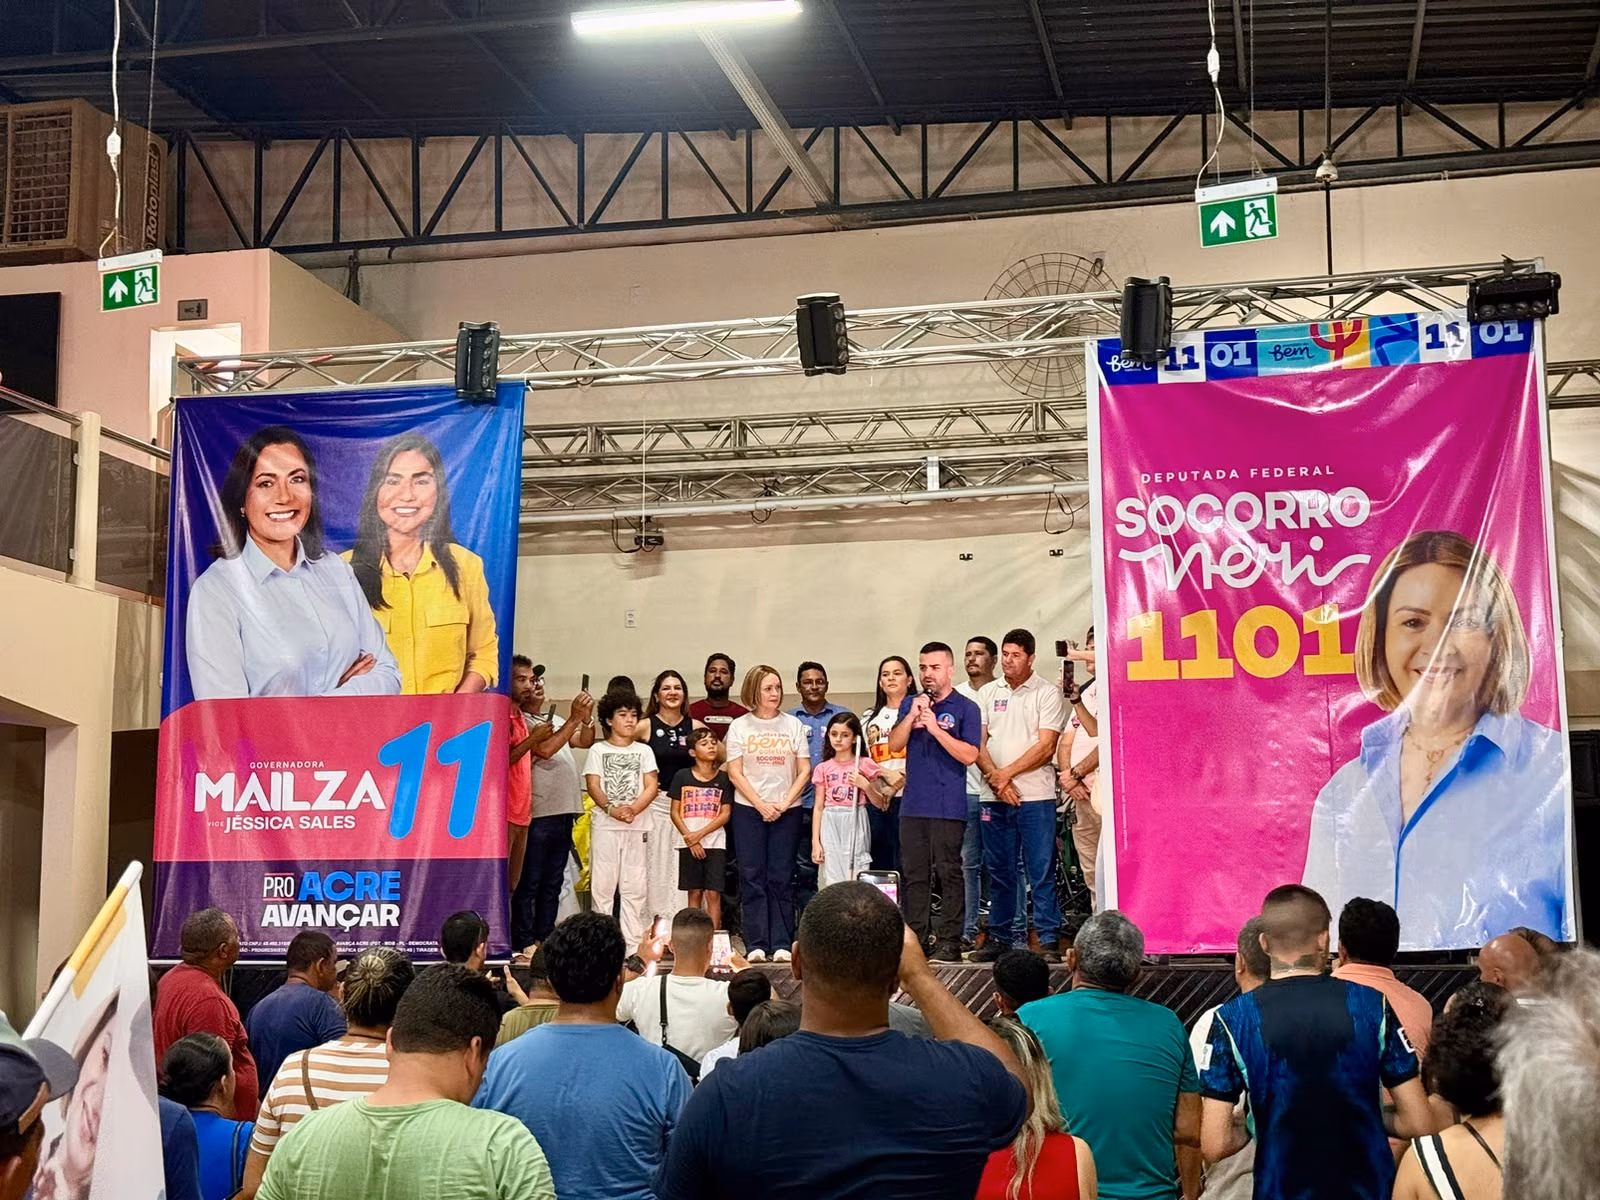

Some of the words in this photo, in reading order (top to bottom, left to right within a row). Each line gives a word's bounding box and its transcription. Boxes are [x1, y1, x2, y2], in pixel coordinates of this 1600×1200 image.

[1425, 321, 1465, 350] 11
[1479, 320, 1524, 345] 01
[1164, 345, 1200, 371] 11
[1210, 342, 1252, 368] 01
[1268, 344, 1315, 361] Bem
[1141, 468, 1240, 484] DEPUTADA
[1250, 465, 1335, 479] FEDERAL
[1115, 486, 1371, 538] SOCORRO
[1118, 535, 1372, 591] neri
[1127, 604, 1356, 681] 1101
[250, 761, 325, 769] GOVERNADORA
[378, 721, 493, 839] 11
[194, 770, 386, 812] MAILZA
[224, 814, 295, 834] JÉSSICA
[299, 815, 356, 829] SALES
[262, 875, 295, 899] PRO
[298, 871, 401, 901] ACRE
[261, 903, 401, 932] AVANÇAR
